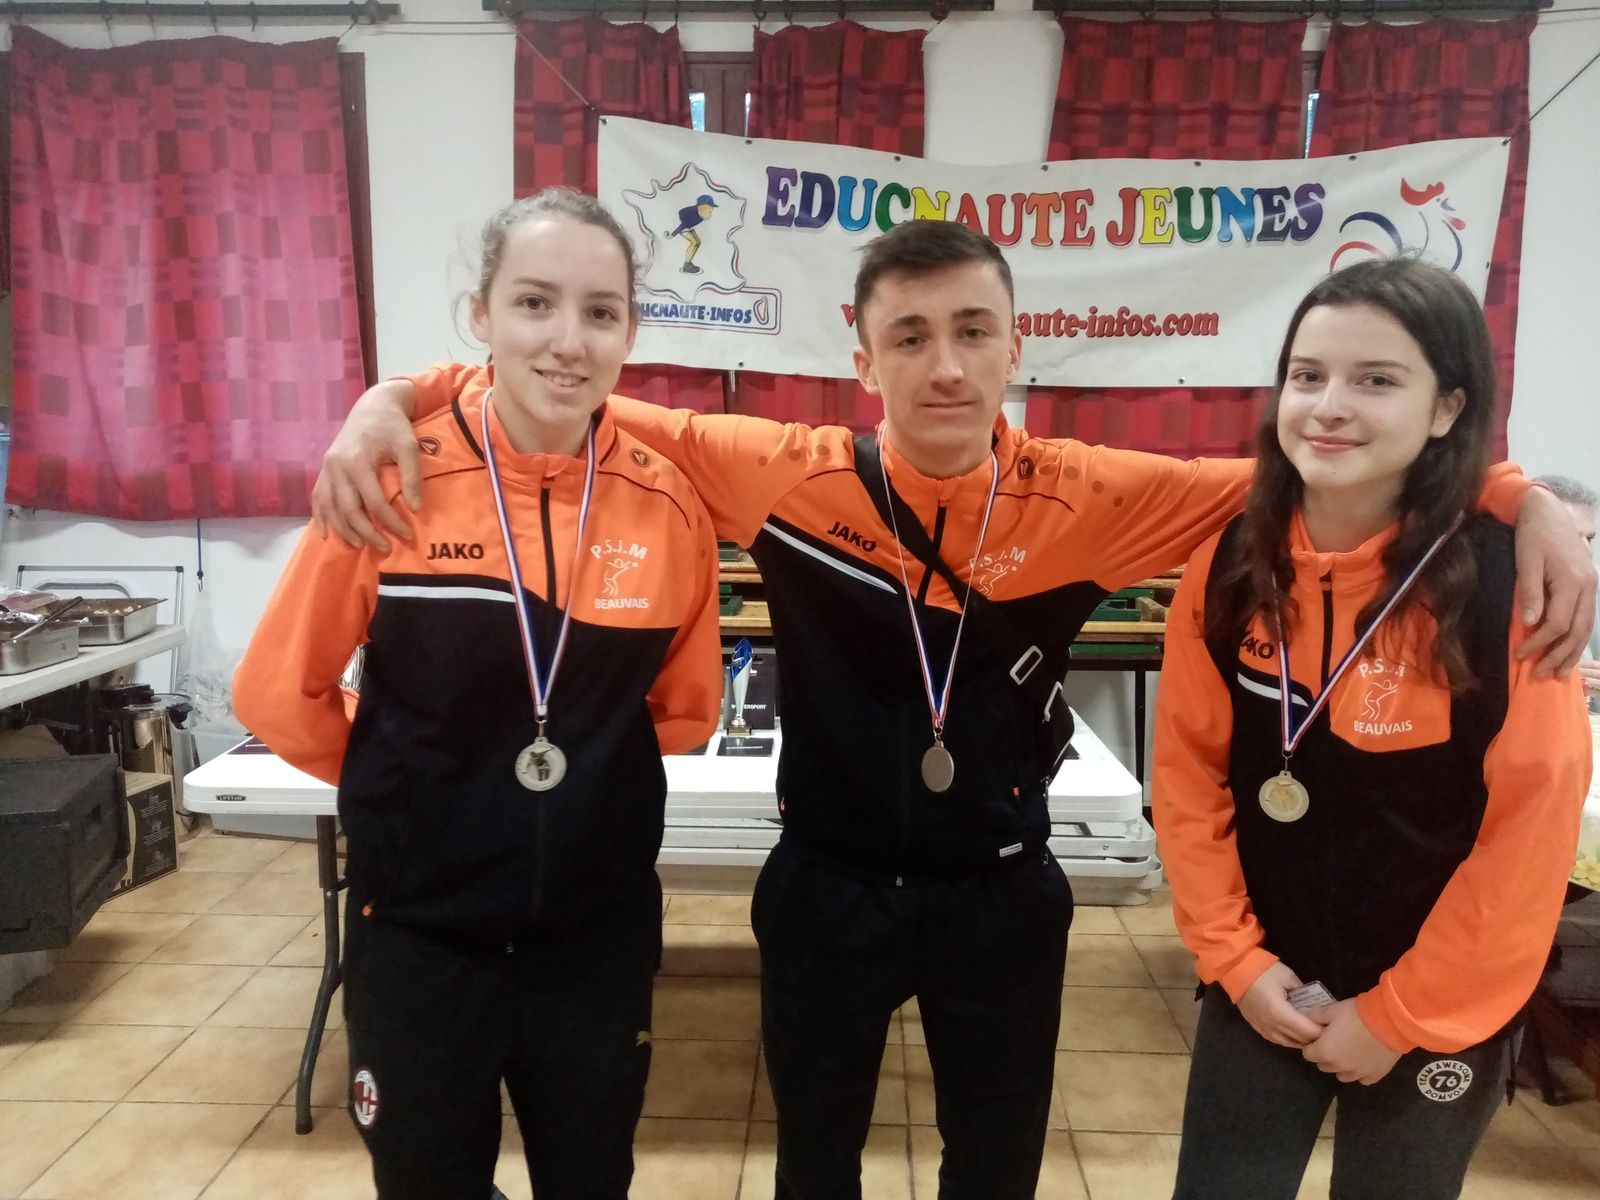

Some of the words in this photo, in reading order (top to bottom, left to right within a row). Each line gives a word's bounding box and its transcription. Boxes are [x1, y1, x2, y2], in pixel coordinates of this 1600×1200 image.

[761, 166, 1095, 247] EDUCNAUTE
[1105, 182, 1326, 249] JEUNES
[827, 521, 877, 552] JAKO
[426, 543, 485, 561] JAKO
[594, 597, 650, 610] BEAUVAIS
[1353, 720, 1413, 736] BEAUVAIS
[1435, 1061, 1471, 1083] AWESOME
[1435, 1076, 1457, 1088] 76
